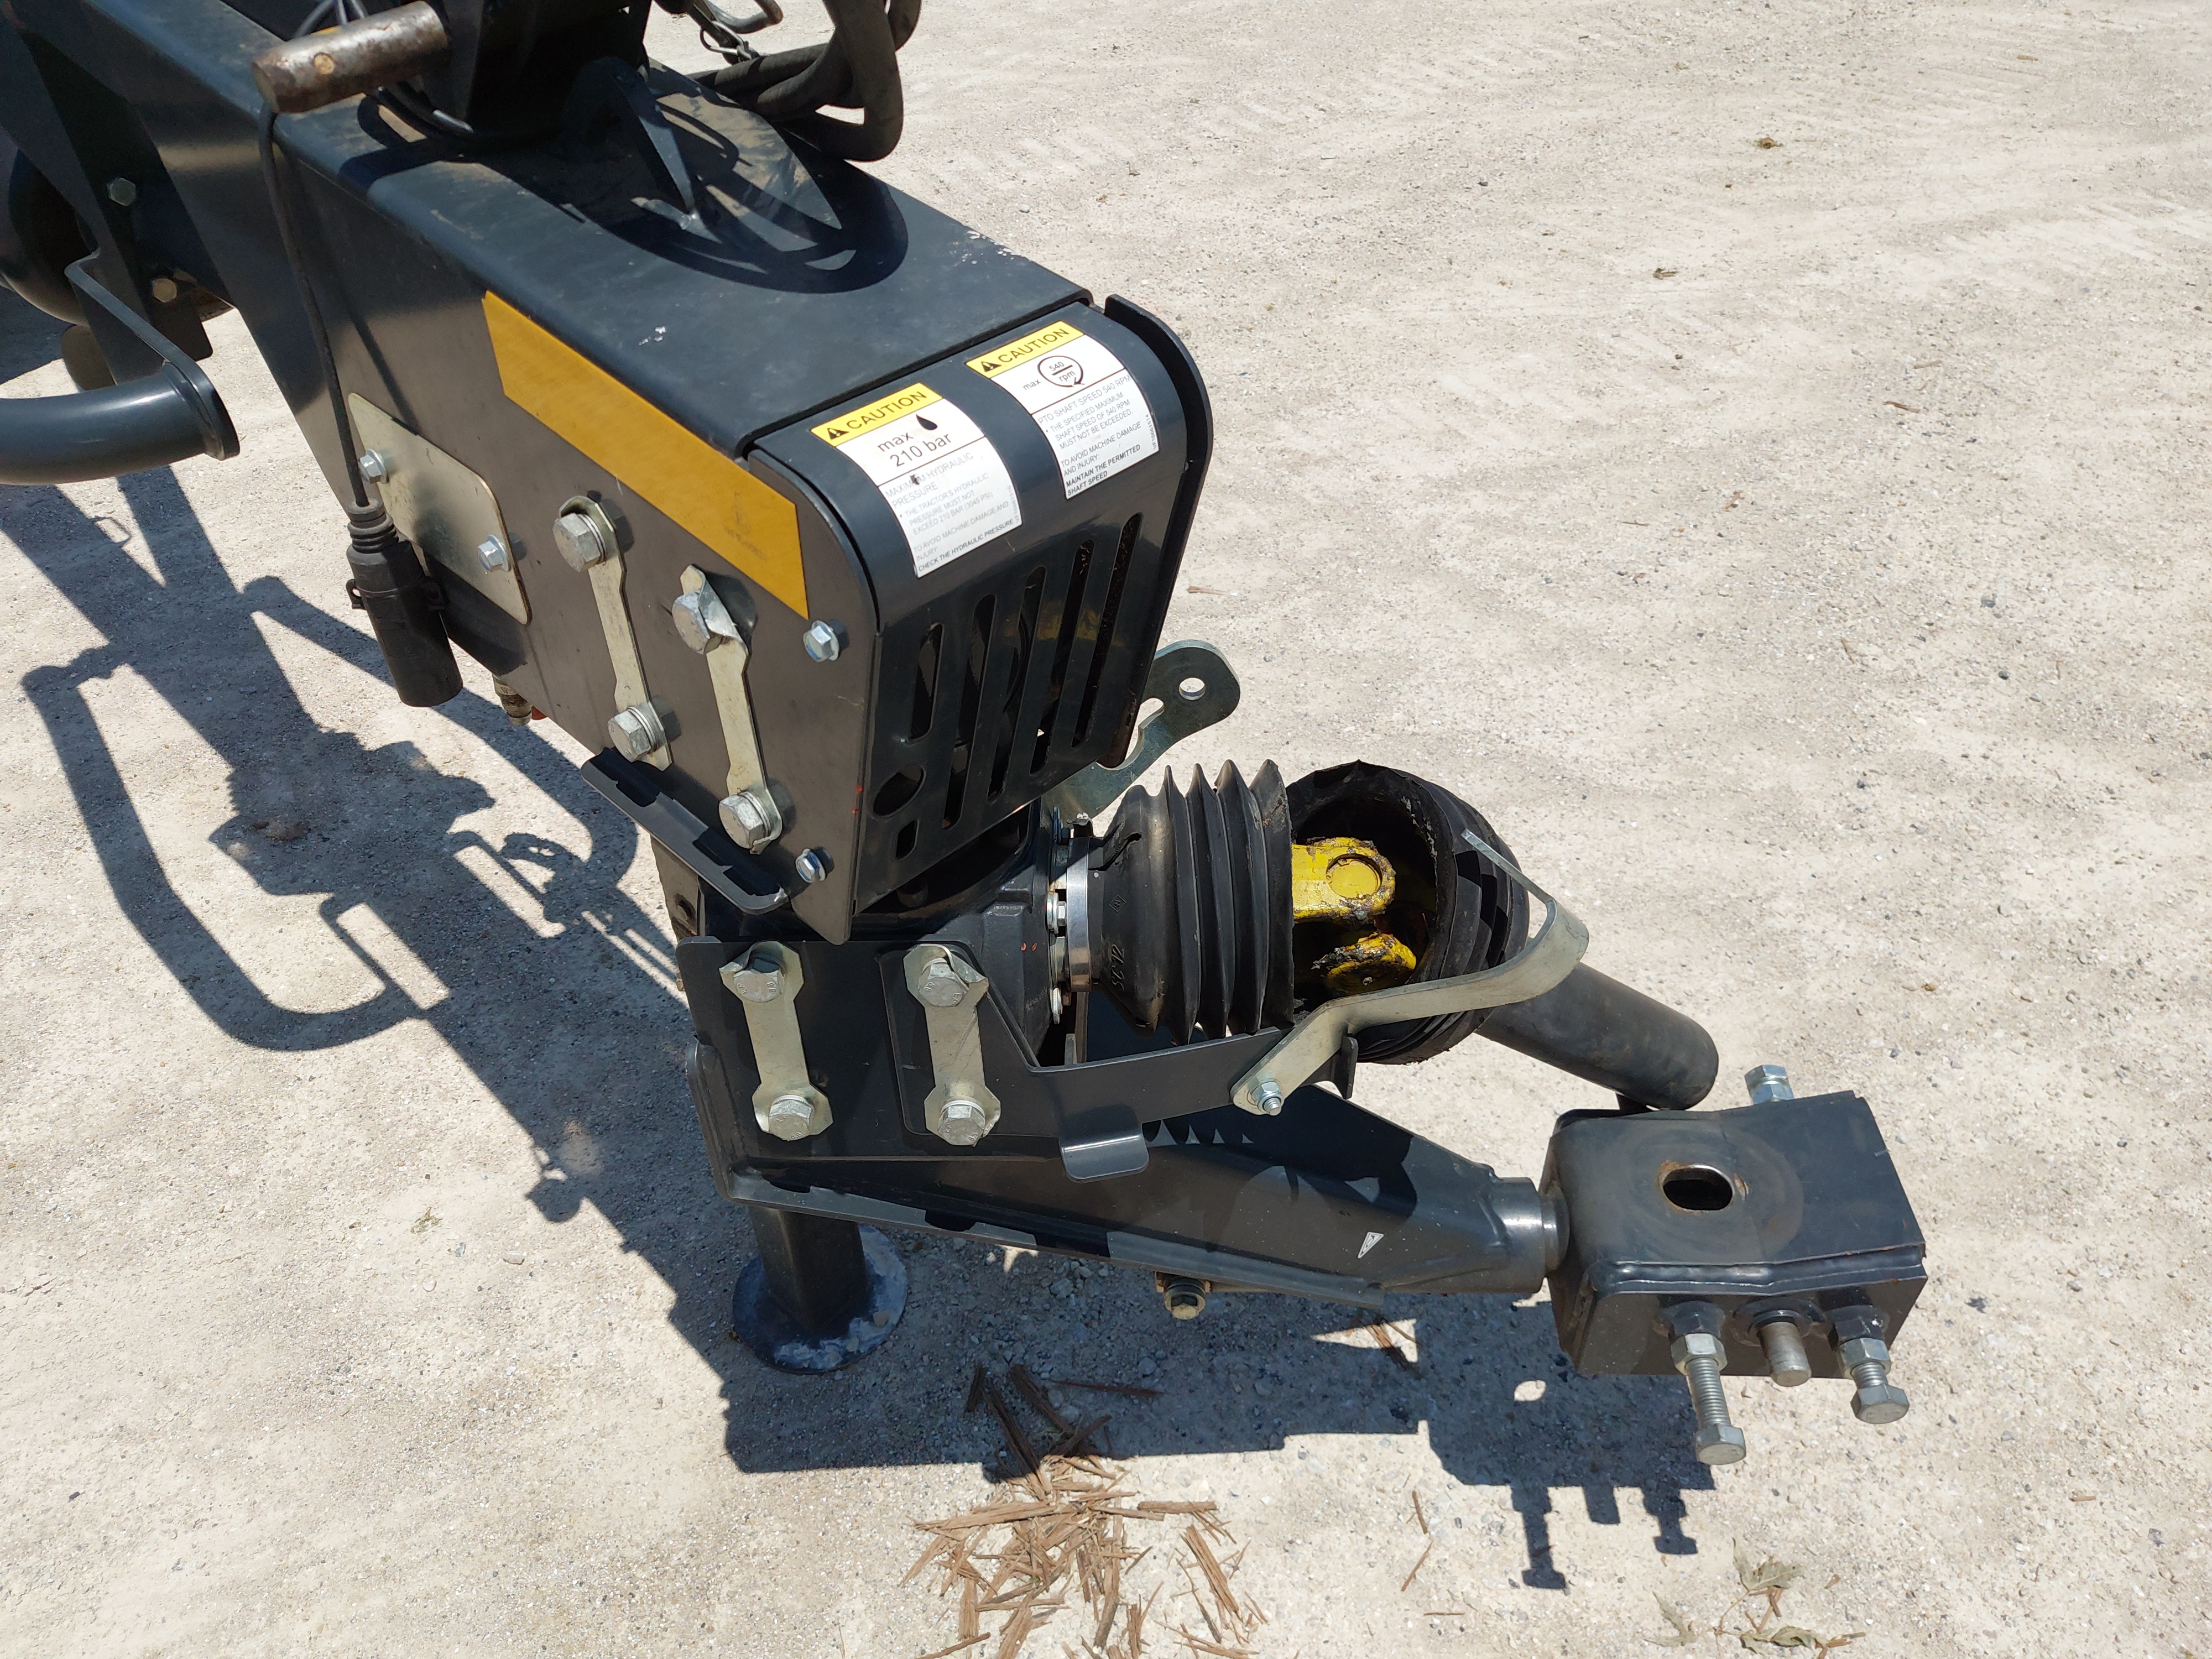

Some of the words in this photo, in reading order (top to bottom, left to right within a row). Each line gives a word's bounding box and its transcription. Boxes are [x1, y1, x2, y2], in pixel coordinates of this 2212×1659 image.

[998, 328, 1070, 363] CAUTION
[1048, 362, 1065, 372] 540
[1058, 370, 1076, 382] rpm
[1022, 379, 1042, 390] max
[1037, 413, 1054, 426] PTO
[1054, 401, 1077, 417] SHAFT
[1078, 389, 1103, 406] SPEED
[1103, 383, 1116, 394] 540
[1115, 374, 1131, 388] RPM
[846, 391, 927, 429] CAUTION
[1050, 421, 1064, 433] THE
[1064, 407, 1095, 426] SPECIFIED
[1094, 392, 1124, 411] MAXIMUM
[1055, 427, 1076, 441] SHAFT
[1077, 416, 1096, 431] SPEED
[1097, 411, 1105, 420] OF
[1105, 406, 1117, 416] 540
[1117, 399, 1130, 410] RPM
[877, 432, 914, 452] max
[1059, 435, 1077, 450] MUST
[1078, 429, 1091, 441] NOT
[1091, 425, 1100, 434] BE
[1100, 409, 1133, 429] EXCEEDED.
[1061, 459, 1070, 468] TO
[1071, 449, 1088, 464] AVOID
[1089, 436, 1116, 453] MACHINE
[1117, 421, 1141, 440] DAMAGE
[890, 445, 922, 467] 210
[922, 434, 952, 452] bar
[926, 452, 973, 479] HYDRAULIC
[1066, 468, 1094, 487] MAINTAIN
[1095, 461, 1107, 472] THE
[1108, 444, 1141, 466] PERMITTED
[1064, 466, 1076, 477] AND
[1067, 481, 1087, 496] SHAFT
[1088, 471, 1108, 486] SPEED
[891, 481, 939, 509] PRESSURE
[905, 507, 918, 517] THE
[954, 473, 989, 493] HYDRAULIC
[909, 506, 943, 526] PRESSURE
[943, 495, 962, 509] MUST
[961, 489, 975, 502] NOT
[914, 519, 939, 535] EXCEED
[940, 513, 951, 523] 210
[951, 505, 964, 517] BAR
[914, 545, 922, 553] TO
[923, 535, 942, 549] AVOID
[942, 522, 969, 540] MACHINE
[970, 508, 996, 525] DAMAGE
[997, 501, 1009, 513] AND
[919, 557, 939, 572] CHECK
[940, 551, 951, 561] THE
[951, 535, 984, 555] HYDRAULIC
[984, 518, 1014, 539] PRESSURE
[1111, 944, 1124, 964] 12
[1111, 965, 1124, 991] SC
